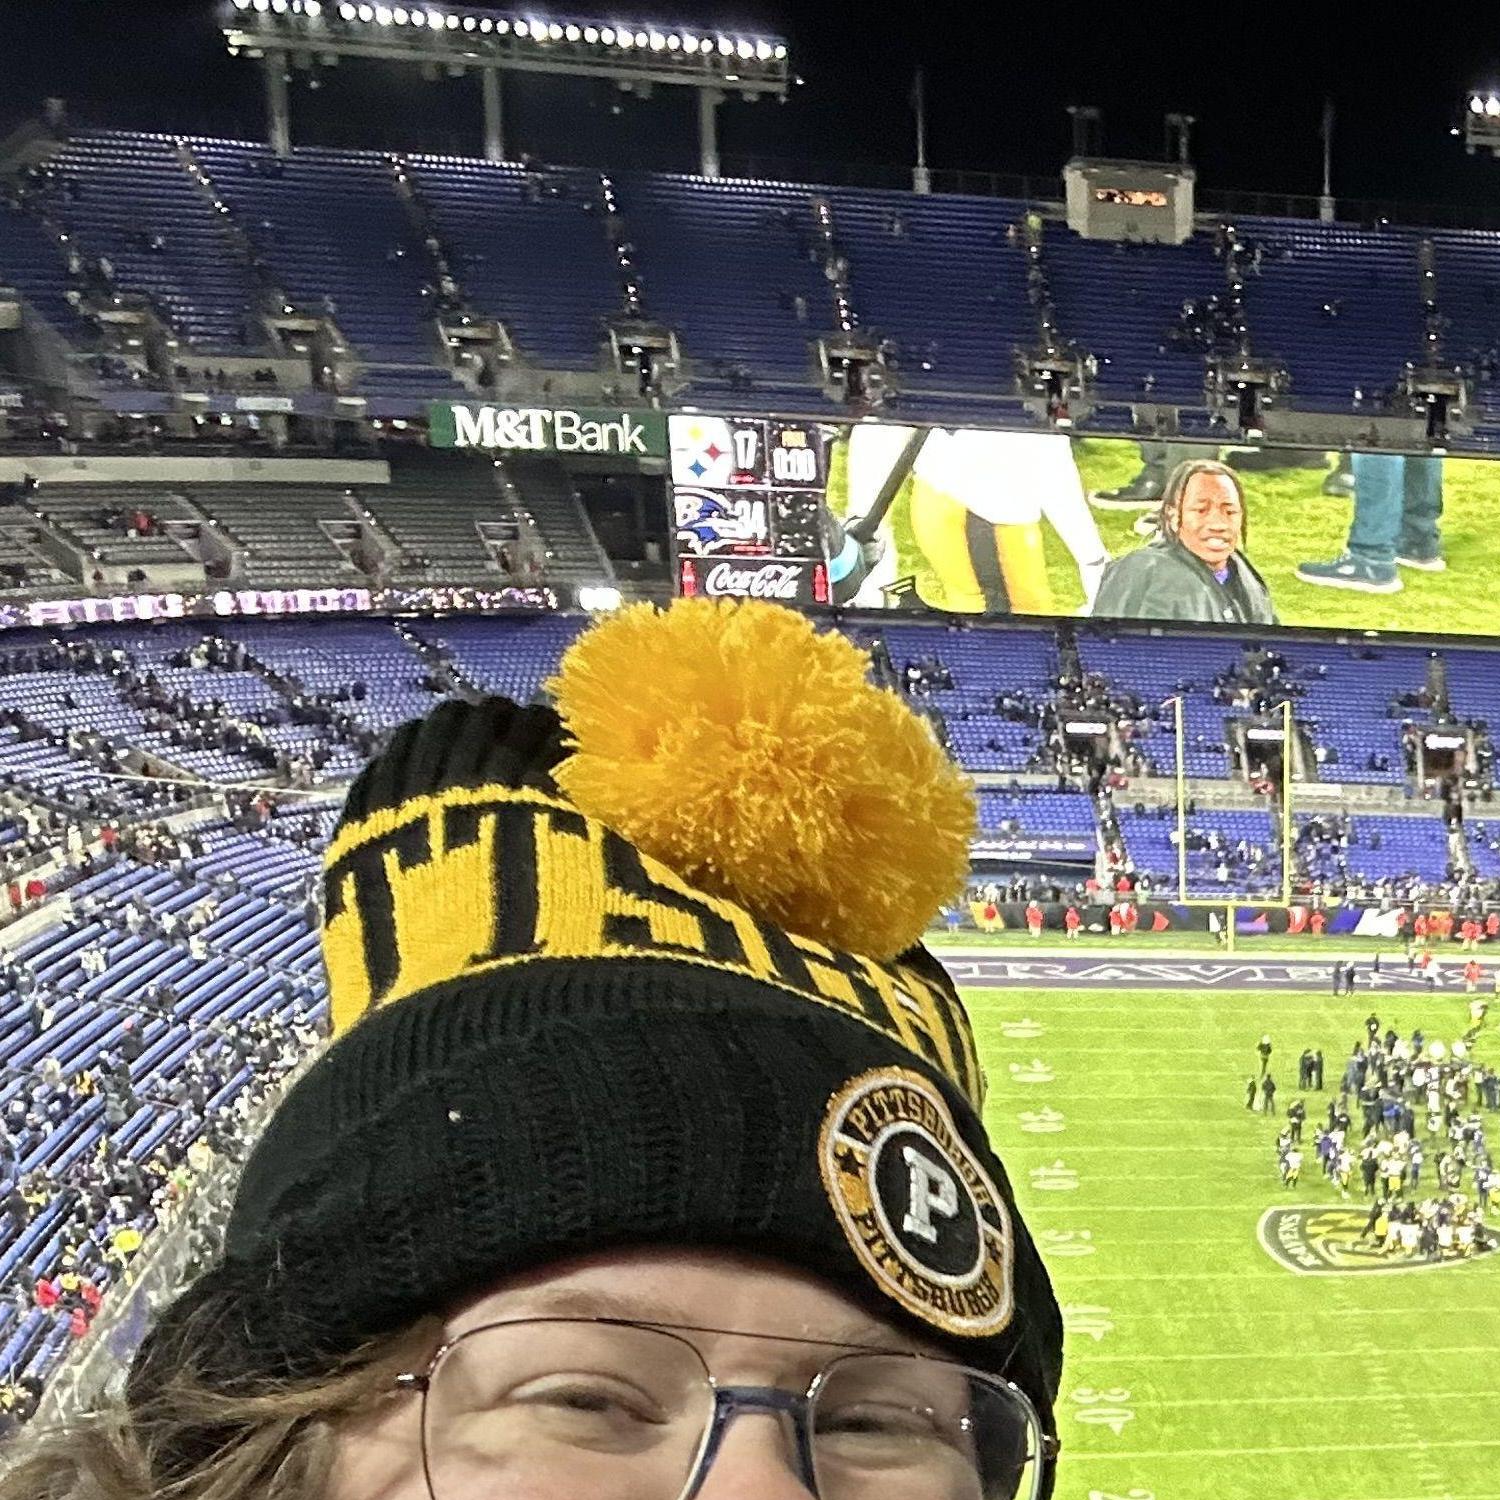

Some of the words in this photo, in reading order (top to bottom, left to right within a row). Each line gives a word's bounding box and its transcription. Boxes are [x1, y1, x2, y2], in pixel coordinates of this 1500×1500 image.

[451, 405, 553, 449] M&T
[555, 411, 647, 454] Bank
[902, 1145, 959, 1244] P
